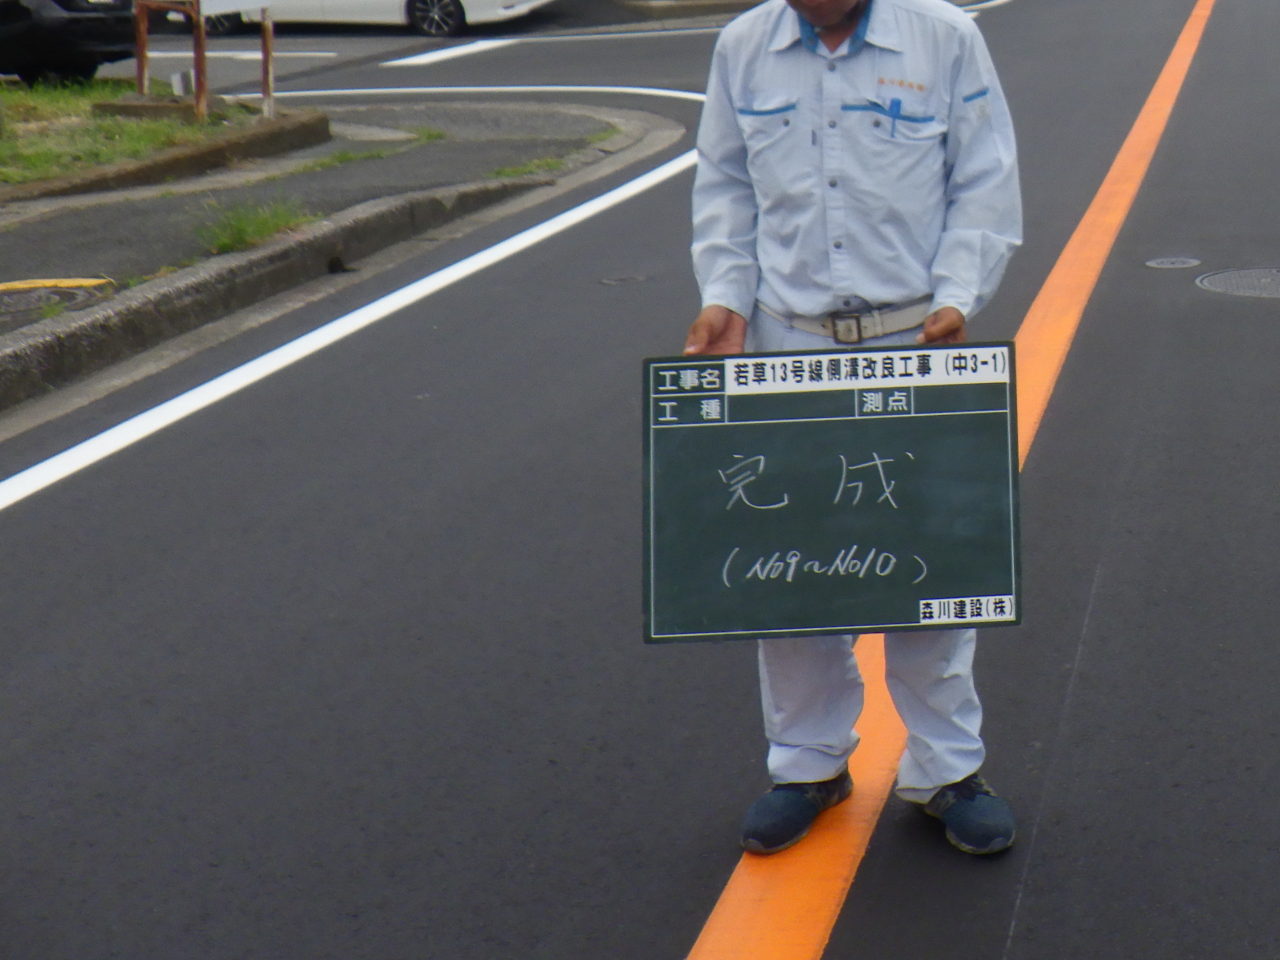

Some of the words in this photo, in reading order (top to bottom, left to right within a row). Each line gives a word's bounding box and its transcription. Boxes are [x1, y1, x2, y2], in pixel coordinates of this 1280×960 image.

[657, 368, 721, 391] 工事名
[861, 391, 909, 413] 測点
